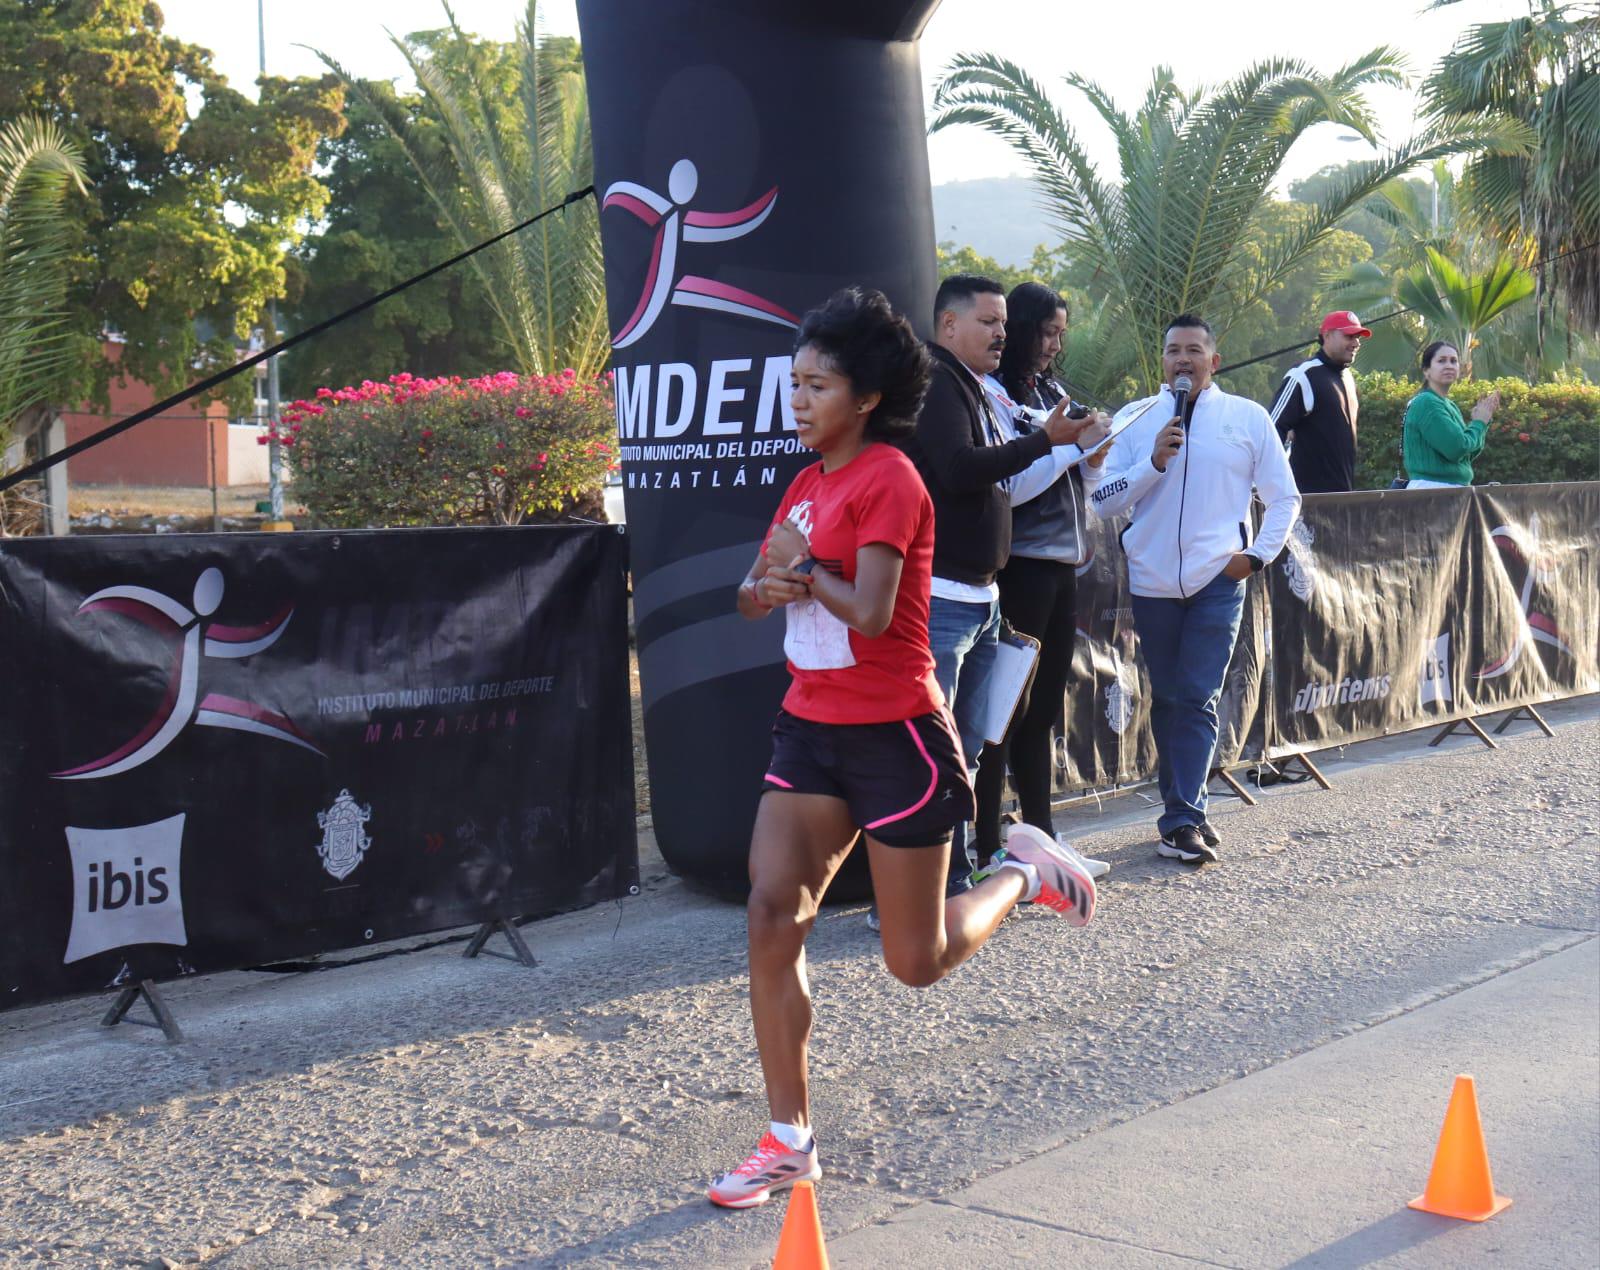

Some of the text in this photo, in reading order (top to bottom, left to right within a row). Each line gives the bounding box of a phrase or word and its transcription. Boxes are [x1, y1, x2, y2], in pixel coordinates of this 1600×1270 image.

[643, 443, 712, 461] MUNICIPAL
[716, 442, 746, 459] DEL
[628, 465, 776, 489] MAZATLÁN
[318, 675, 554, 715] INSTITUTO MUNICIPAL DEL DEPORTE
[88, 857, 169, 913] ibis
